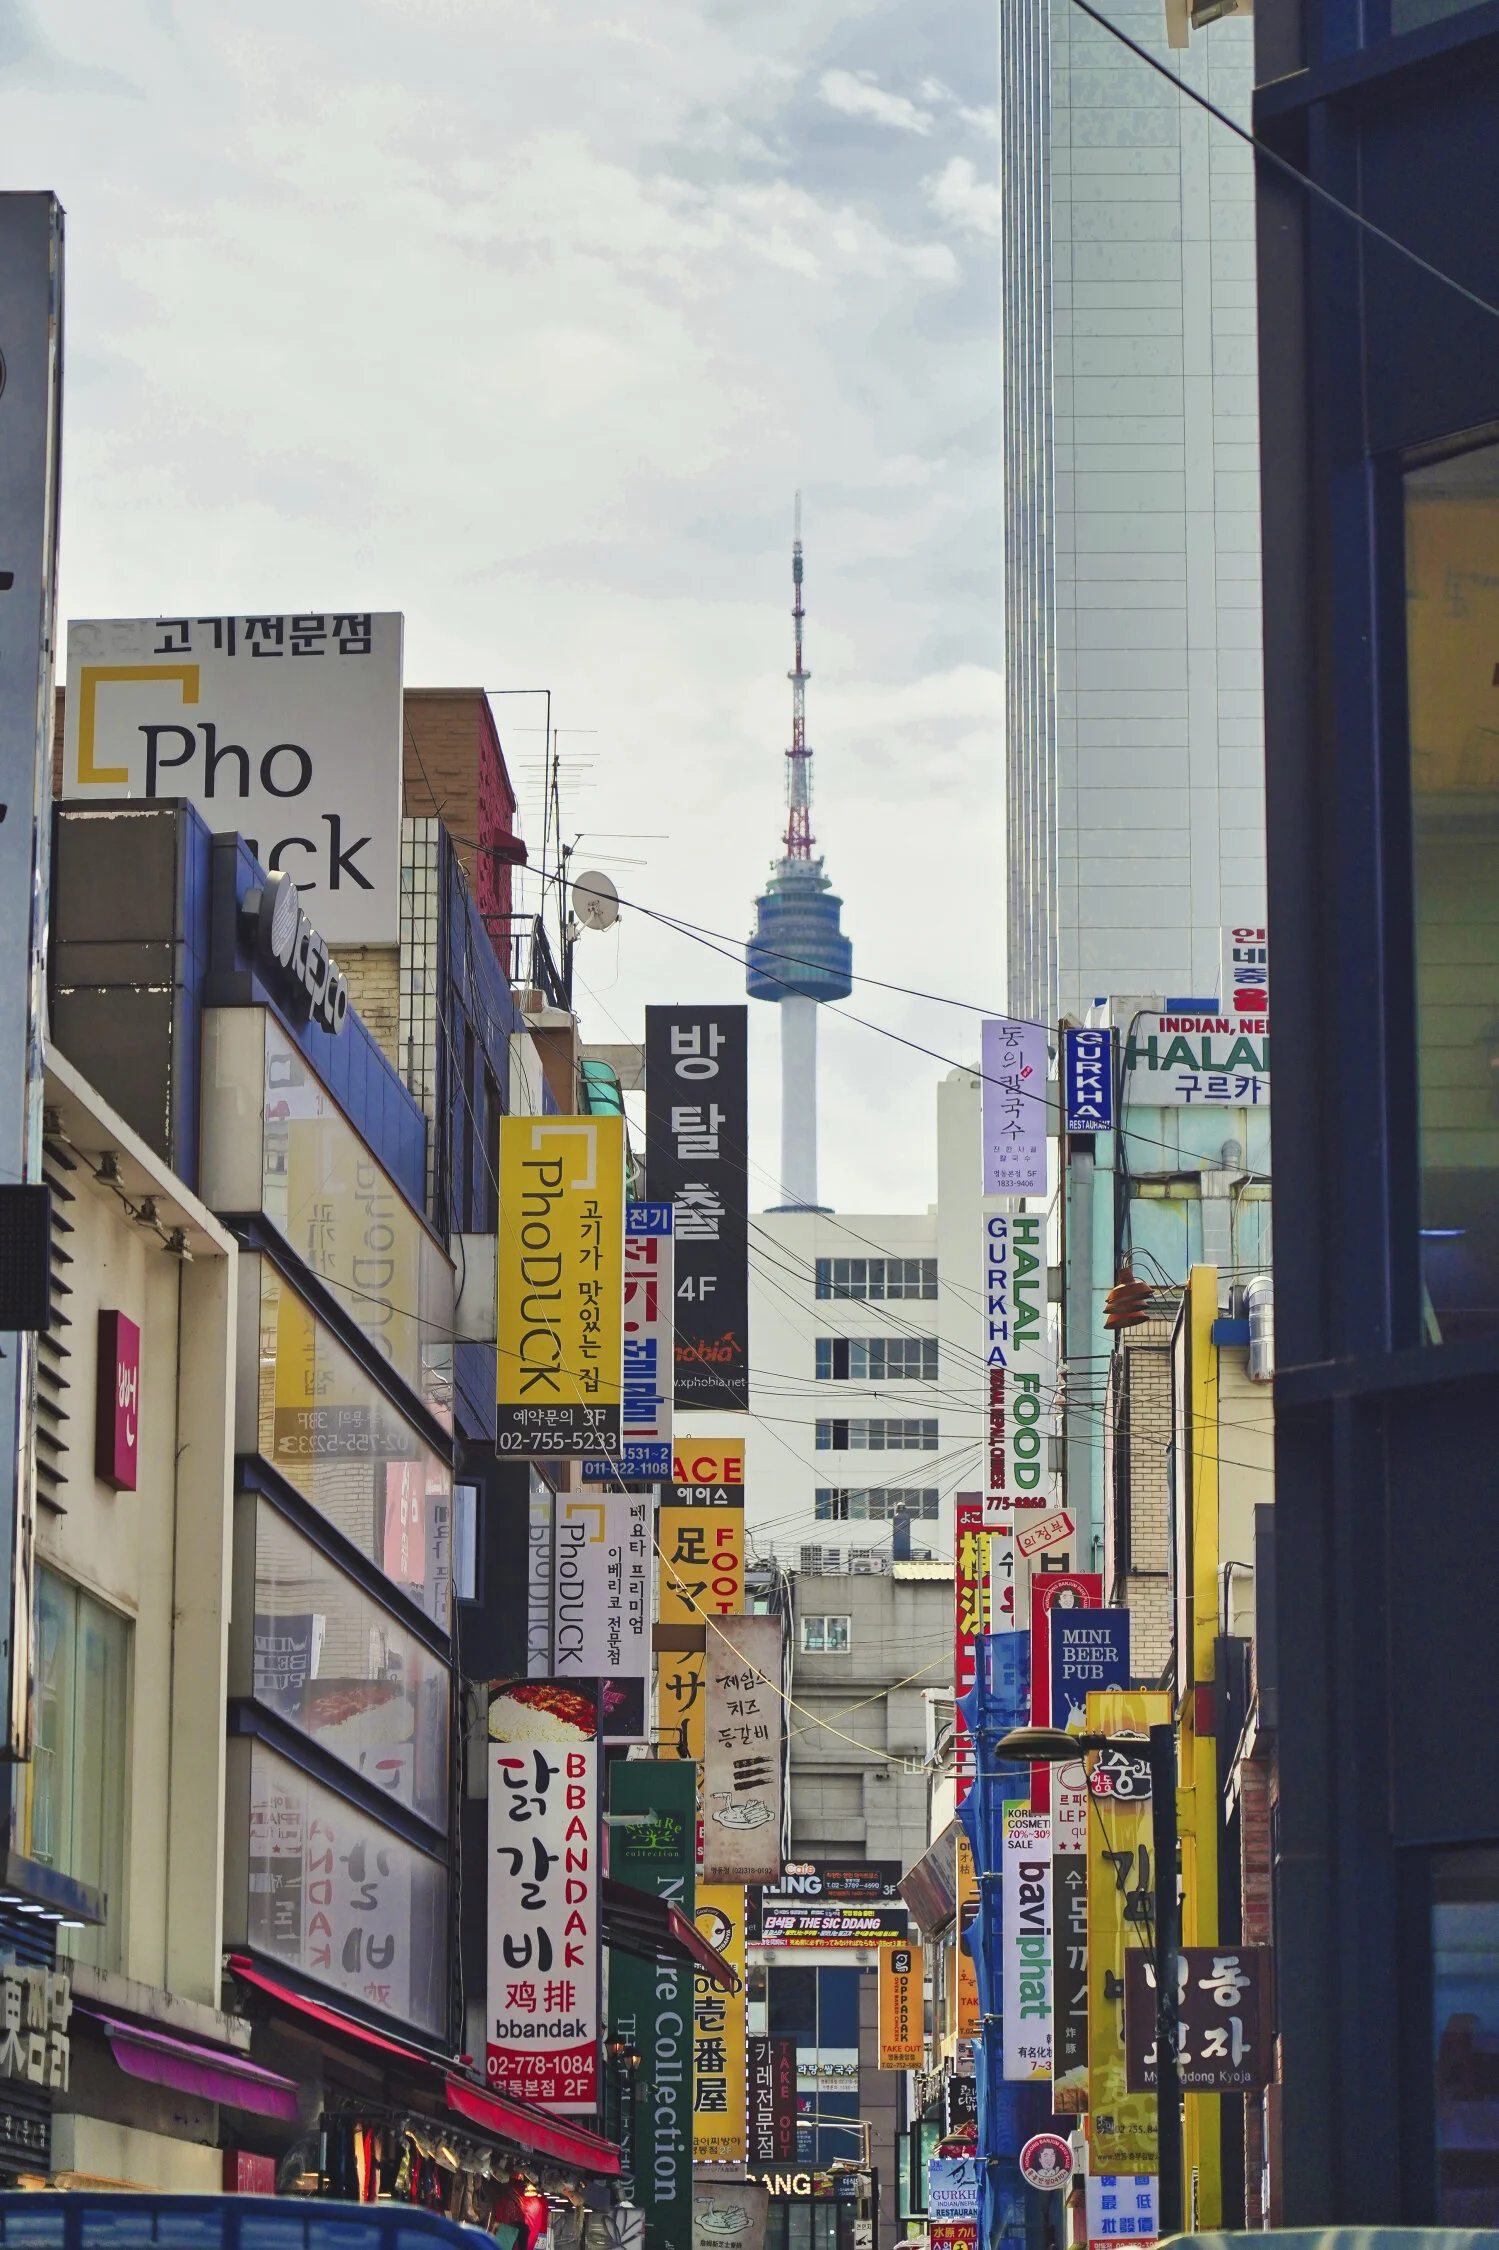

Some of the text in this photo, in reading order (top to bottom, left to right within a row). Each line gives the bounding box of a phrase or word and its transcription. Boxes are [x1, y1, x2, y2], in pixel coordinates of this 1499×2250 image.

[154, 614, 372, 657] 고기전문점
[138, 722, 313, 798] Pho
[251, 814, 376, 891] ck
[1160, 1018, 1270, 1036] INDIAN, NE
[1074, 1032, 1102, 1118] GURKHA
[1176, 1075, 1262, 1104] 구르카
[670, 1023, 726, 1243] 방탈출
[1069, 1120, 1111, 1131] RESTAURANT
[998, 1180, 1034, 1188] 1833-9406
[625, 1209, 668, 1230] 전기
[520, 1157, 562, 1395] PhoDUCK
[578, 1200, 603, 1394] 고기가 맛있는 집
[677, 1276, 717, 1301] 4F
[987, 1217, 1008, 1366] GURKHA
[1013, 1219, 1040, 1489] HALAL FOOD
[513, 1409, 607, 1427] 예약문의 3F
[500, 1431, 617, 1452] 02-755-5233
[584, 1462, 669, 1475] 011-822-1108
[674, 1457, 741, 1484] ACE
[677, 1487, 728, 1505] 에이스
[960, 1512, 983, 1525] よこ
[1024, 1520, 1064, 1549] 의정부
[629, 1504, 647, 1635] 베요타 프리미엄
[558, 1523, 585, 1665] PhoDUCK
[607, 1547, 622, 1666] 이베리코 전문점
[1062, 1629, 1112, 1644] MINI
[1062, 1647, 1119, 1662] BEER
[1062, 1664, 1104, 1680] PUB
[726, 1700, 760, 1716] 치즈
[719, 1724, 769, 1748] 등갈비
[1059, 1795, 1069, 1805] 르
[1008, 1820, 1051, 1829] COSMETI
[1059, 1811, 1074, 1822] LE
[1008, 1841, 1033, 1849] SALE
[497, 1749, 559, 1972] 닭갈비
[564, 1752, 588, 1968] BBANDAK
[785, 1863, 816, 1875] Cafe
[883, 1885, 896, 1895] 3F
[765, 1917, 796, 1929] 더식당
[800, 1918, 822, 1929] THE
[822, 1918, 841, 1929] SIC
[841, 1918, 881, 1929] DDANG
[1016, 1861, 1052, 2019] baviphat
[505, 1980, 576, 2014] 鸡排
[900, 1976, 909, 2042] OPPADAK
[496, 2019, 588, 2039] bbandak
[487, 2056, 594, 2075] 02-778-1084
[564, 2079, 589, 2096] 2F
[1220, 2071, 1251, 2083] Kyoja
[654, 2011, 685, 2203] Collection
[755, 2041, 774, 2159] 카레전문점
[779, 2043, 790, 2158] TAKE OUT
[932, 2190, 976, 2201] GURKH
[936, 2209, 977, 2217] RESTAURAN
[957, 2227, 976, 2238] カル
